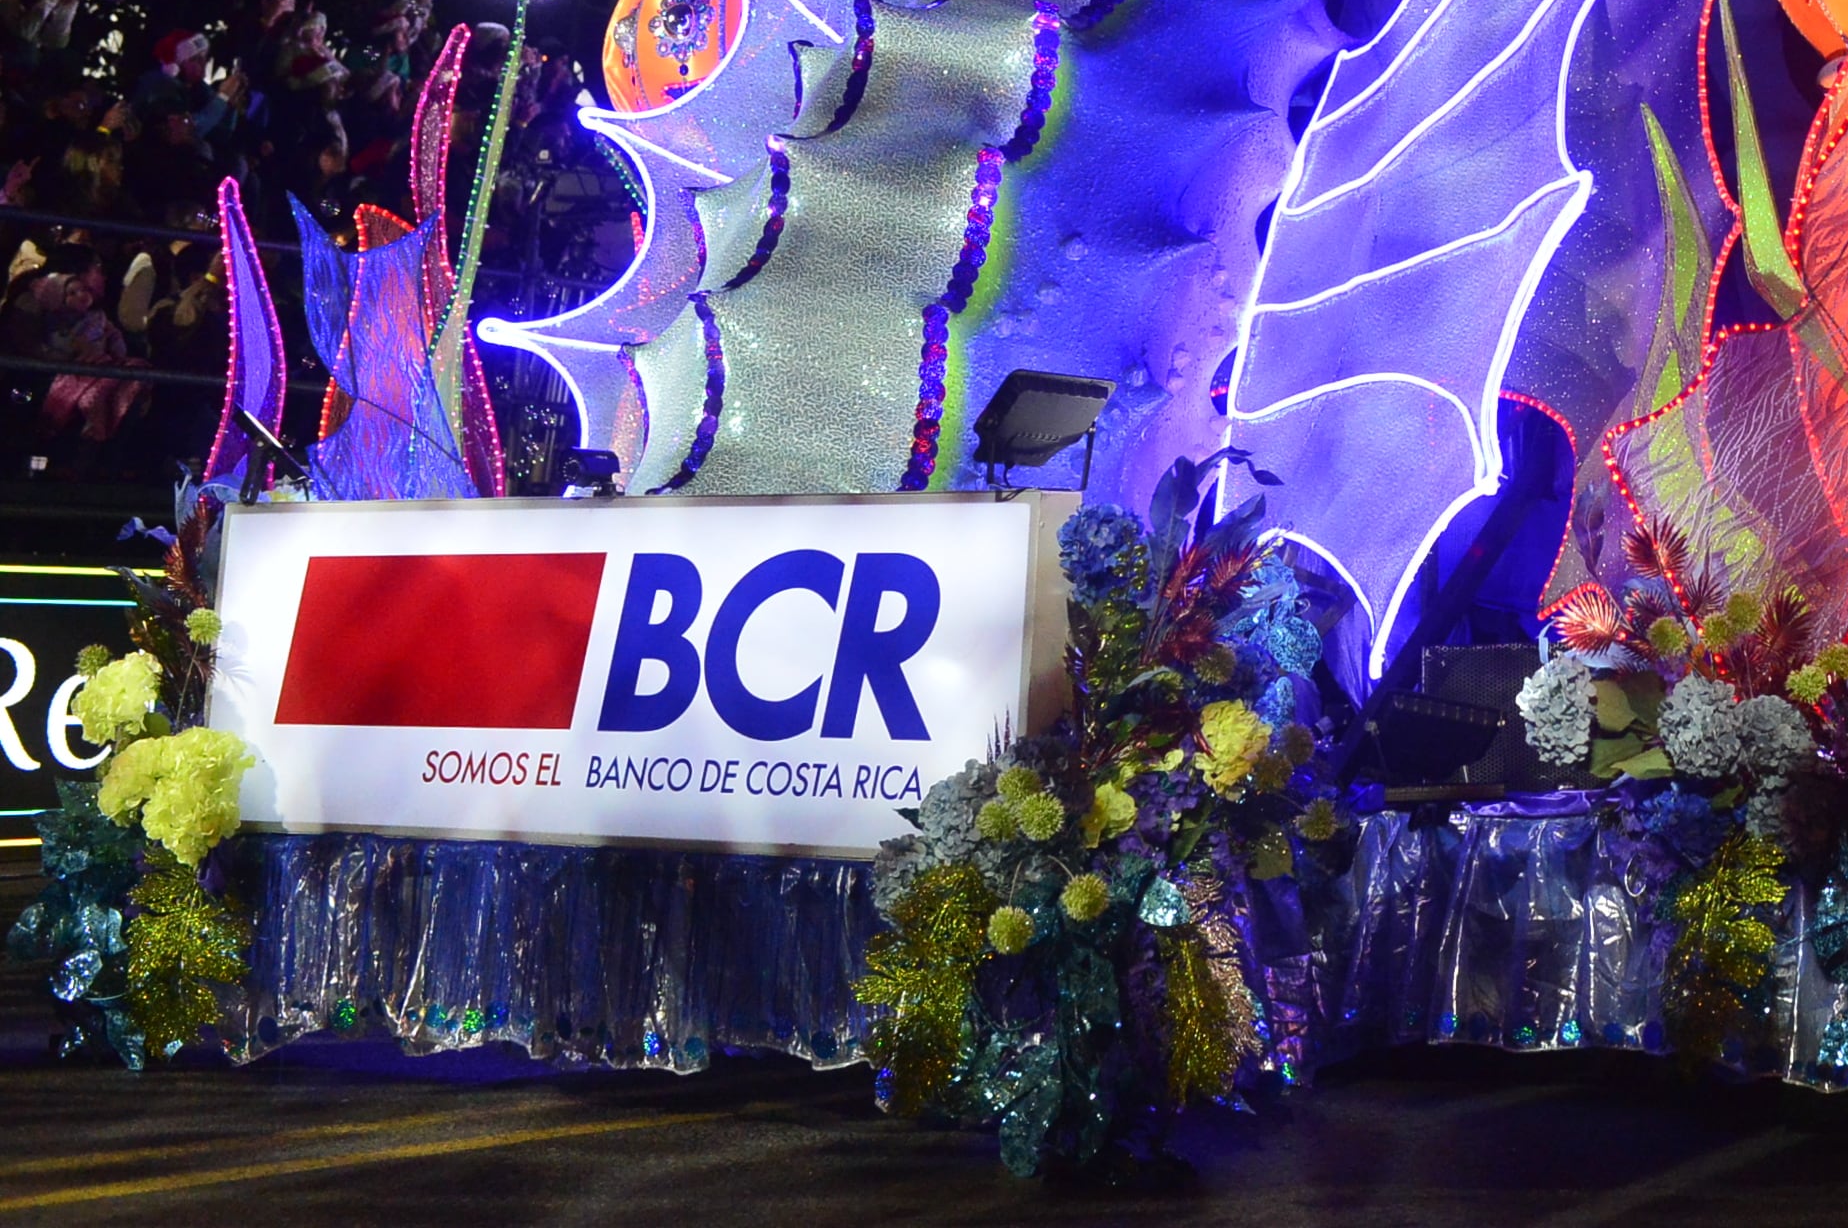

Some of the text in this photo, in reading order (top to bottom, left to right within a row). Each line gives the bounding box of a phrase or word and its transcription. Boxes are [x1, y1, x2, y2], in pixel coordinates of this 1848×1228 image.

[597, 549, 941, 742] BCR
[422, 750, 922, 801] SOMOS EL BANCO DE COSTA RICA
